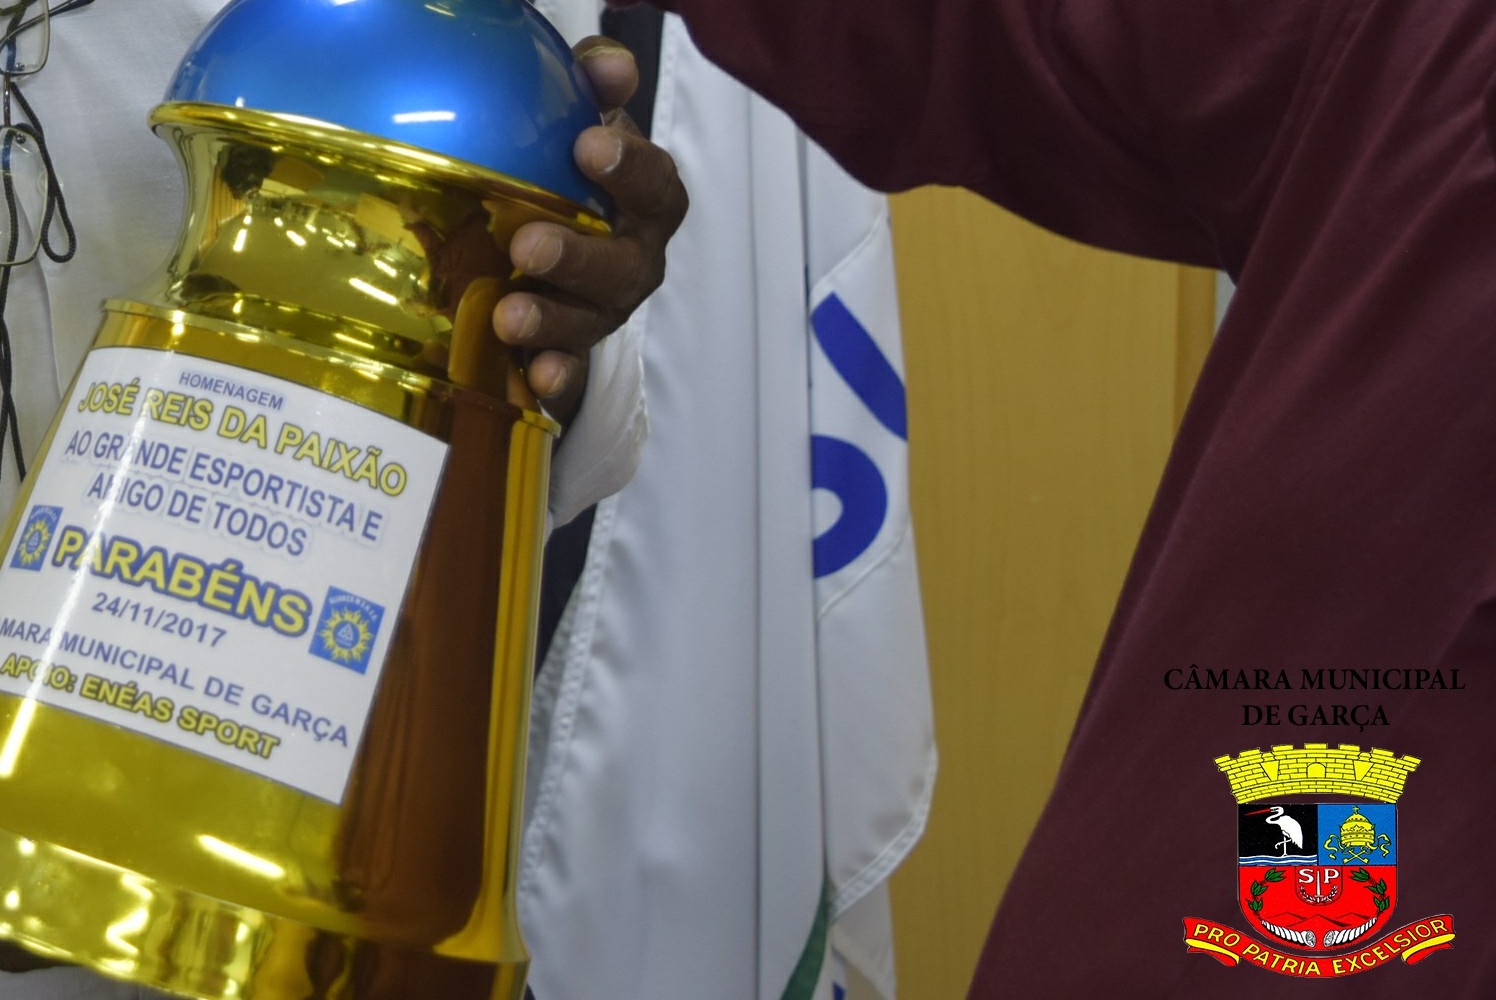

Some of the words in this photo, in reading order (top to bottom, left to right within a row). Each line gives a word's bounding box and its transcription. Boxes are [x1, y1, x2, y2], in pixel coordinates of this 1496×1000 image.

[78, 378, 141, 415] JOSÉ
[140, 388, 213, 431] REIS
[219, 407, 268, 449] DA
[277, 424, 407, 496] PAIXÃO
[179, 371, 284, 410] HOMENAGEM
[66, 431, 92, 456] AO
[190, 453, 355, 532] ESPORTISTA
[362, 511, 384, 541] E
[168, 490, 208, 524] DE
[213, 502, 307, 556] TODOS
[52, 525, 313, 638] PARABÉNS
[92, 592, 227, 648] 24/11/2017
[57, 634, 194, 690] MUNICIPAL
[203, 676, 244, 706] DE
[251, 693, 349, 748] GARÇA
[80, 675, 174, 722] ENÉAS
[177, 705, 280, 760] SPORT
